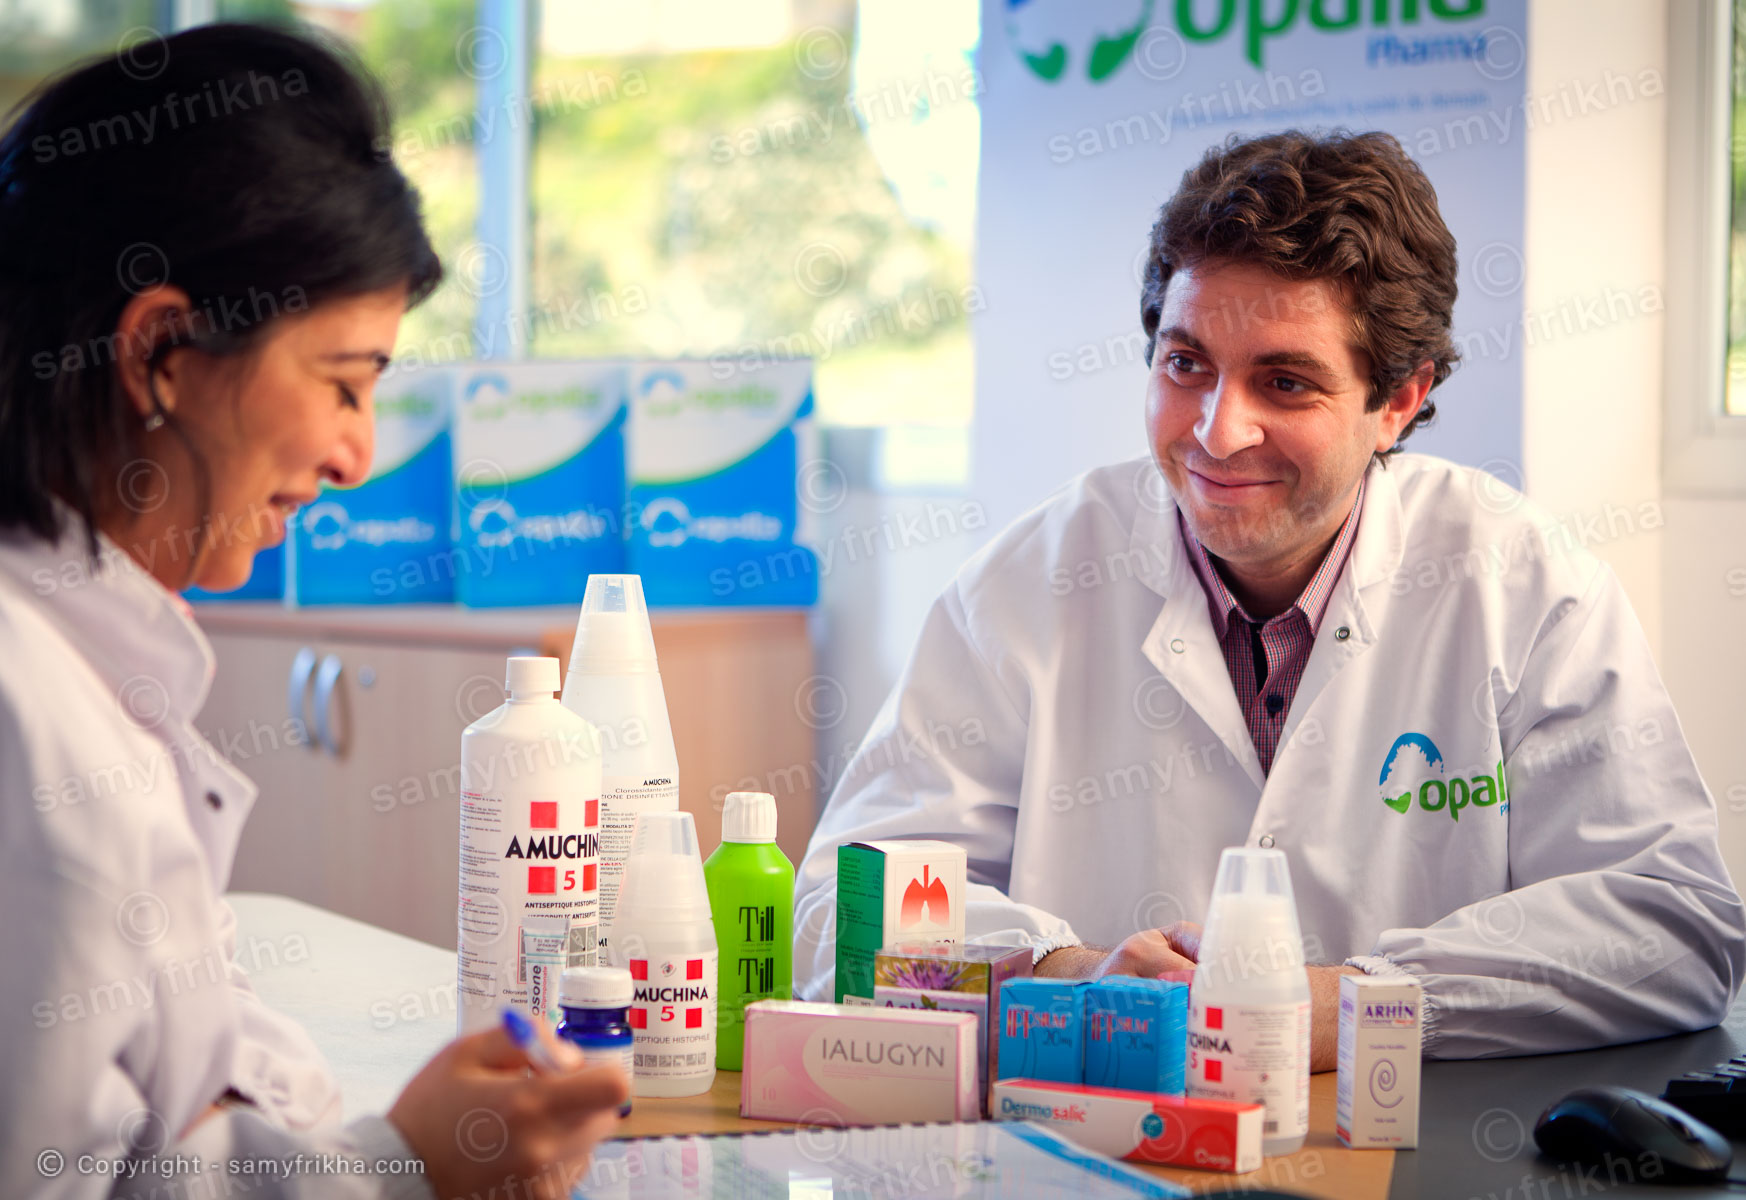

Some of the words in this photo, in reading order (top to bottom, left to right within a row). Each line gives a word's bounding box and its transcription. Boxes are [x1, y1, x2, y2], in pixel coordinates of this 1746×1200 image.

[643, 778, 671, 786] AMUCHINA
[563, 870, 576, 891] 5
[739, 906, 774, 942] Till
[738, 957, 774, 993] Till
[661, 1006, 675, 1022] 5
[822, 1038, 945, 1068] IALUGYN
[1002, 1097, 1087, 1123] Dermosalic
